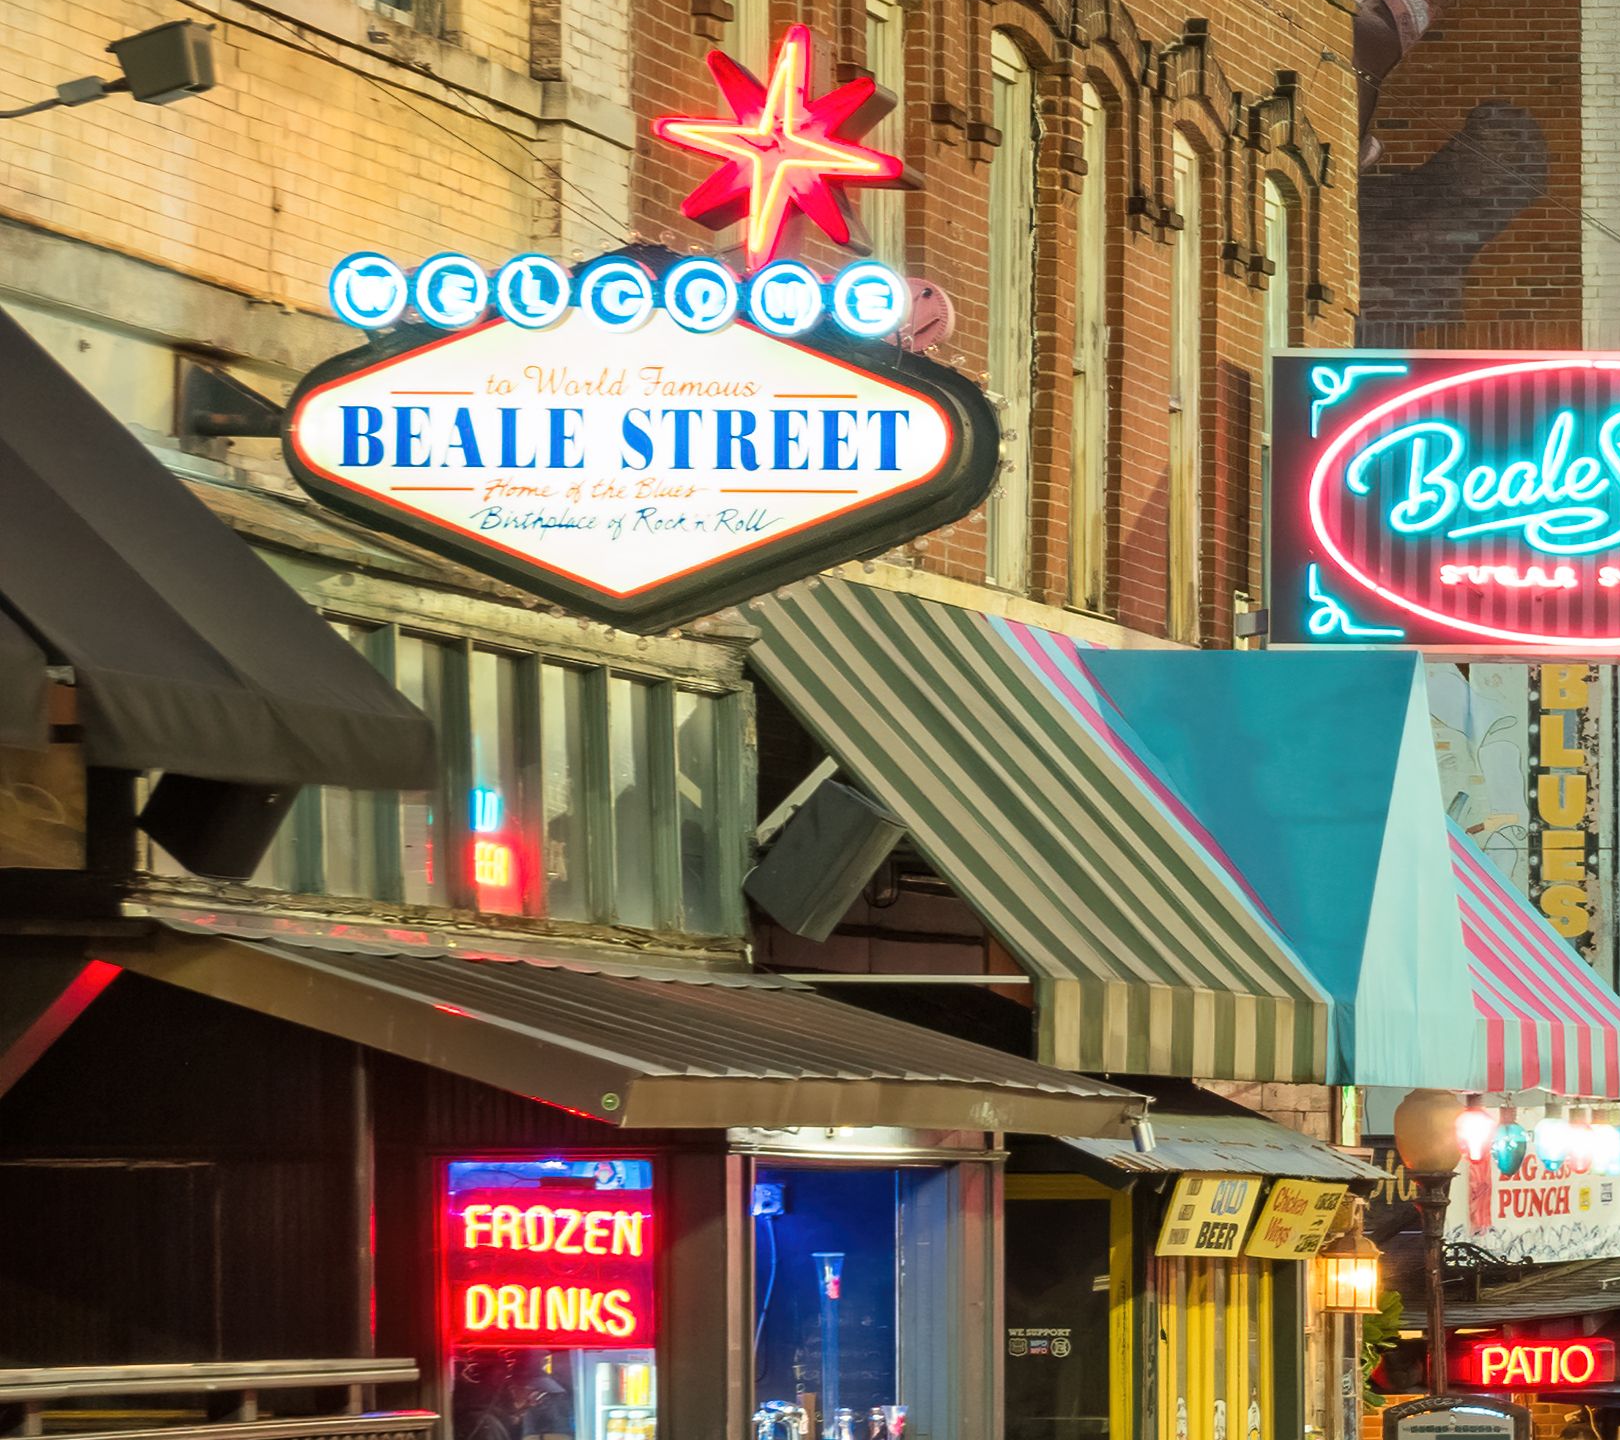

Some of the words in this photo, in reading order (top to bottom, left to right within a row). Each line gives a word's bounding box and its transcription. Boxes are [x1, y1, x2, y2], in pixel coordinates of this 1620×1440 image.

[345, 260, 900, 332] WELCOME
[486, 374, 517, 396] to
[524, 365, 626, 398] World
[639, 366, 761, 398] Famous
[338, 405, 586, 469] BEALE
[620, 406, 912, 472] STREET
[483, 478, 554, 502] Home
[566, 478, 583, 503] of
[591, 478, 627, 499] the
[634, 477, 705, 500] Blues
[470, 506, 598, 541] Birthplace
[606, 509, 623, 540] of
[633, 507, 687, 533] Rock
[713, 508, 784, 533] Roll
[1538, 663, 1591, 939] BLUES
[1498, 1185, 1571, 1219] PUNCH
[464, 1204, 644, 1257] FROZEN
[1195, 1221, 1239, 1250] BEER
[464, 1284, 637, 1338] DRINKS
[1008, 1328, 1025, 1336] WE
[1026, 1328, 1072, 1337] SUPPORT
[1481, 1344, 1596, 1385] PATIO
